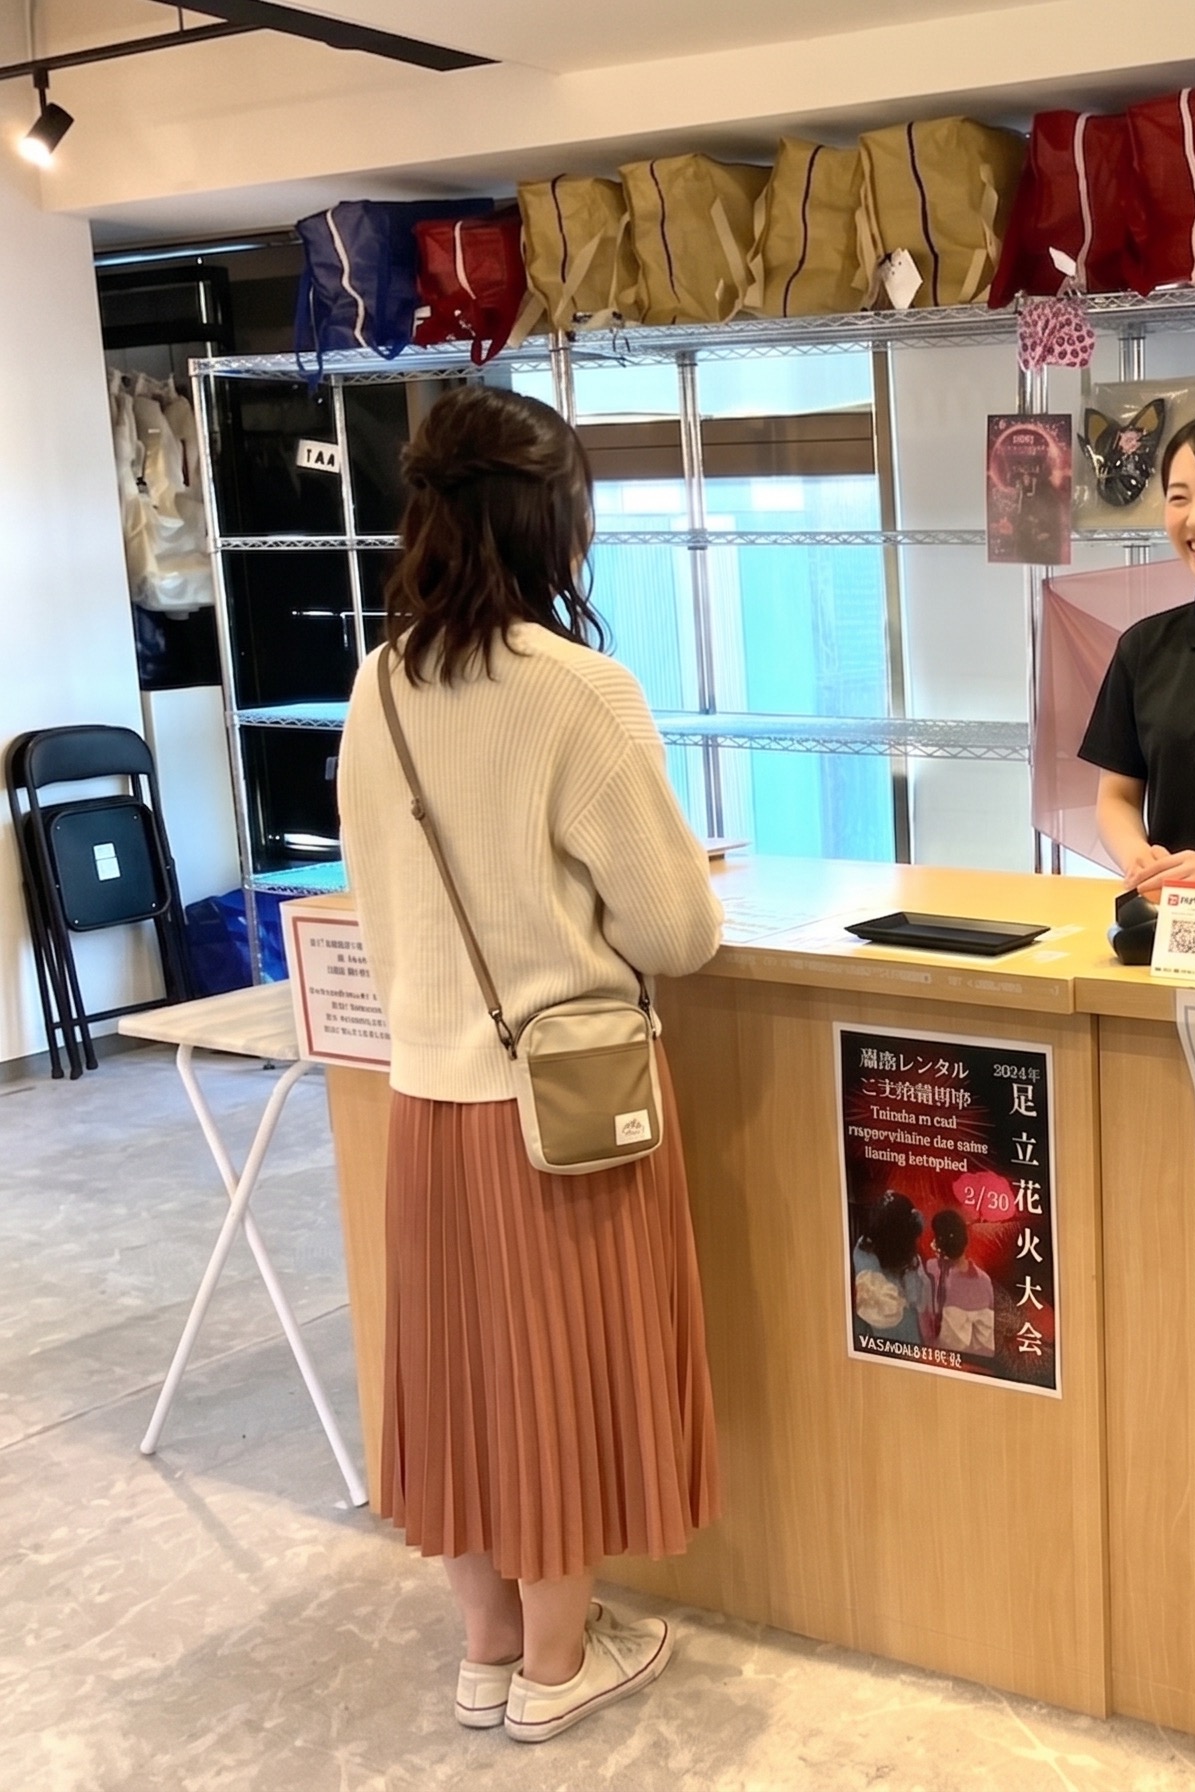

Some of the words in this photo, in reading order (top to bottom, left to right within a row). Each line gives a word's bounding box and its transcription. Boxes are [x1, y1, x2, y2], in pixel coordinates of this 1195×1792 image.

[993, 1063, 1041, 1083] 2024年
[964, 1185, 1009, 1212] 2/30
[1008, 1083, 1044, 1356] 足立花火大会
